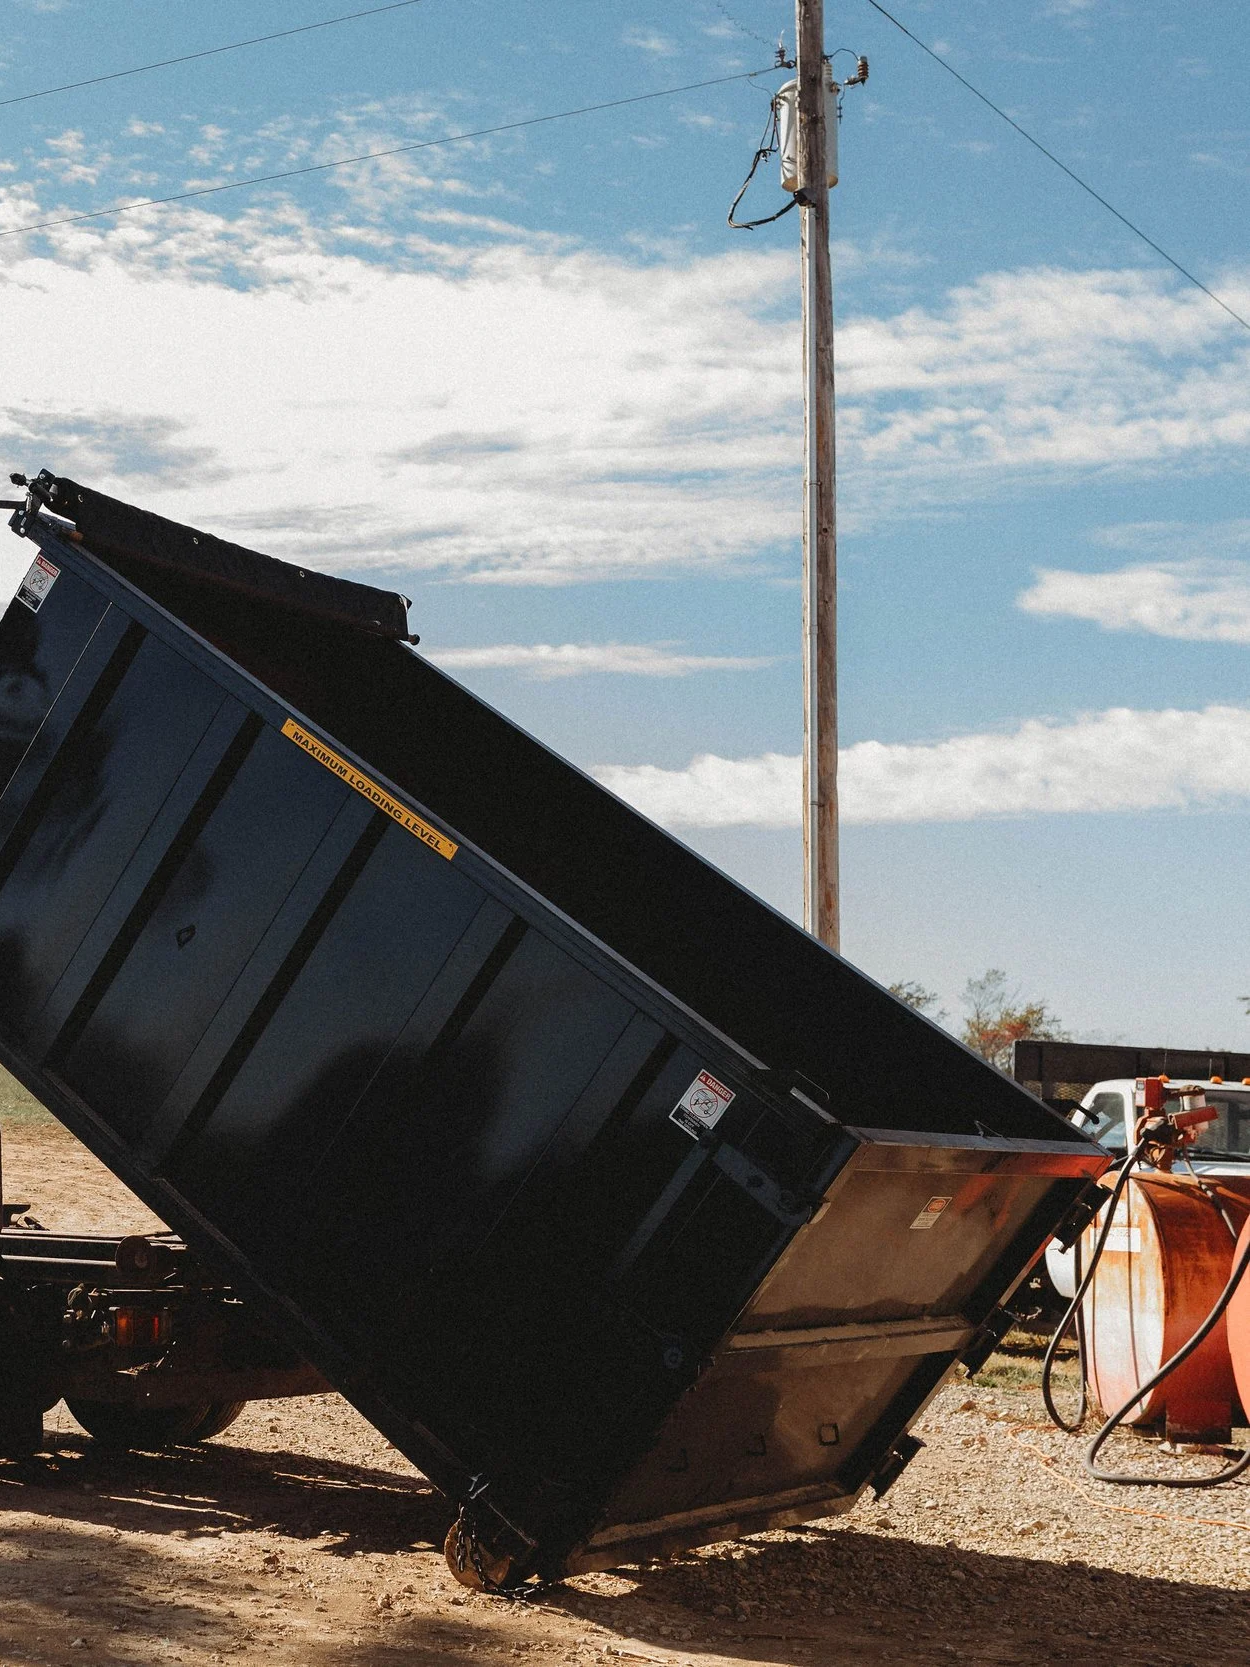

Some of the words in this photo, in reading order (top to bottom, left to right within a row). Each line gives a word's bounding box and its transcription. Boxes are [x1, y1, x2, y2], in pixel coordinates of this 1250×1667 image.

[41, 560, 58, 576] DANGER
[292, 731, 348, 777] MAXIMUM
[348, 774, 402, 819] LOADING
[404, 817, 441, 850] LEVEL
[706, 1079, 732, 1100] DANGER
